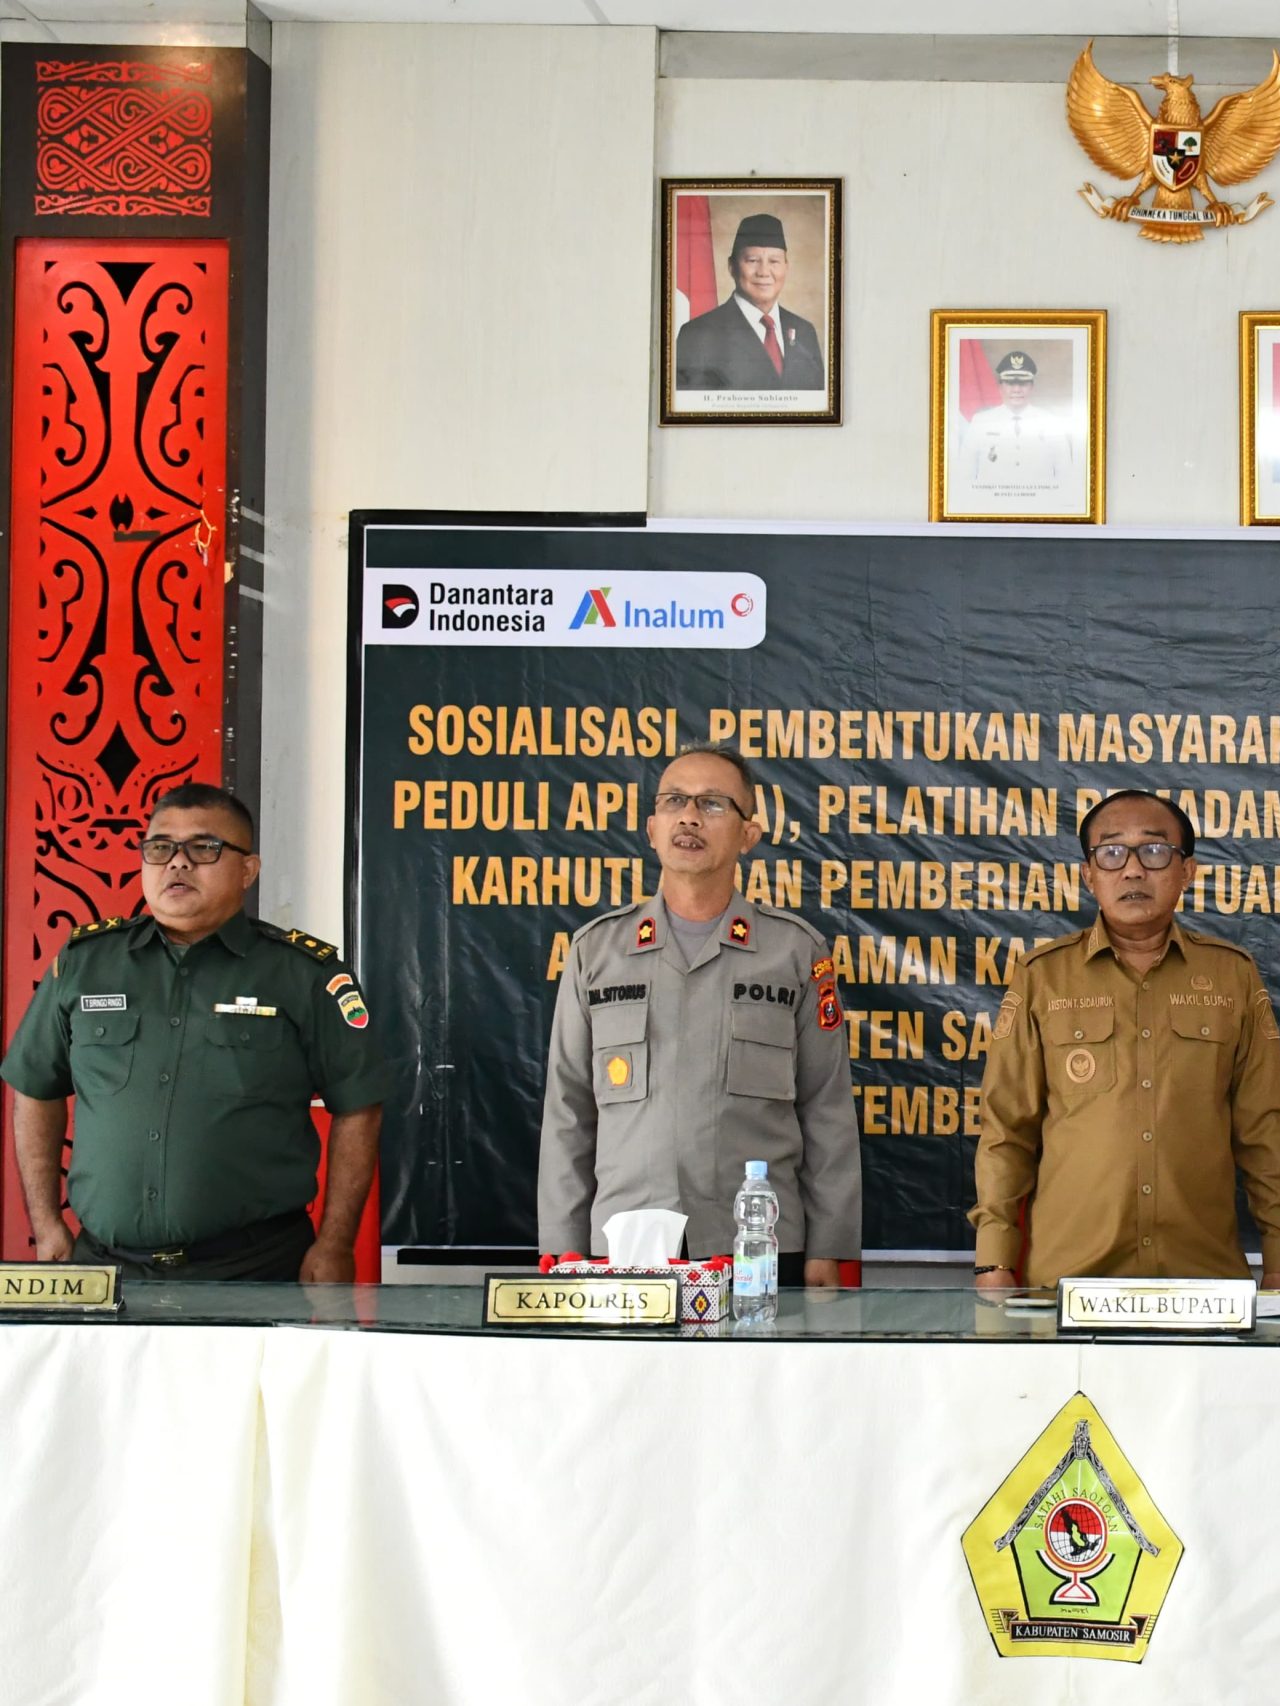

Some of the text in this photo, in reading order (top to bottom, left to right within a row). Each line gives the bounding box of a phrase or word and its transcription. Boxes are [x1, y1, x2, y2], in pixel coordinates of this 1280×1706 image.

[1131, 207, 1166, 219] BHINNEKA
[1169, 211, 1201, 221] TUNGGAL
[430, 582, 554, 606] Danantara
[429, 608, 546, 632] Indonesia
[624, 600, 725, 630] Inalum
[709, 708, 1041, 762] PEMBENTUKAN
[393, 780, 550, 831] PEDULI
[565, 781, 639, 832] API
[751, 784, 801, 845] A),
[818, 785, 1058, 838] PELATIHAN
[452, 855, 663, 906] KARHUTL
[734, 859, 802, 908] AN
[820, 860, 1080, 913] PEMBERIAN
[733, 983, 796, 1007] POLRI
[1169, 993, 1235, 1009] WAKIL BUPATI
[4, 1278, 85, 1296] NDIM
[516, 1292, 649, 1310] KAPOLRES
[1079, 1296, 1236, 1314] WAKIL BUPATI
[1034, 1489, 1067, 1529] SATAHI
[1015, 1625, 1131, 1642] KABUPATEN SAMOSIR
